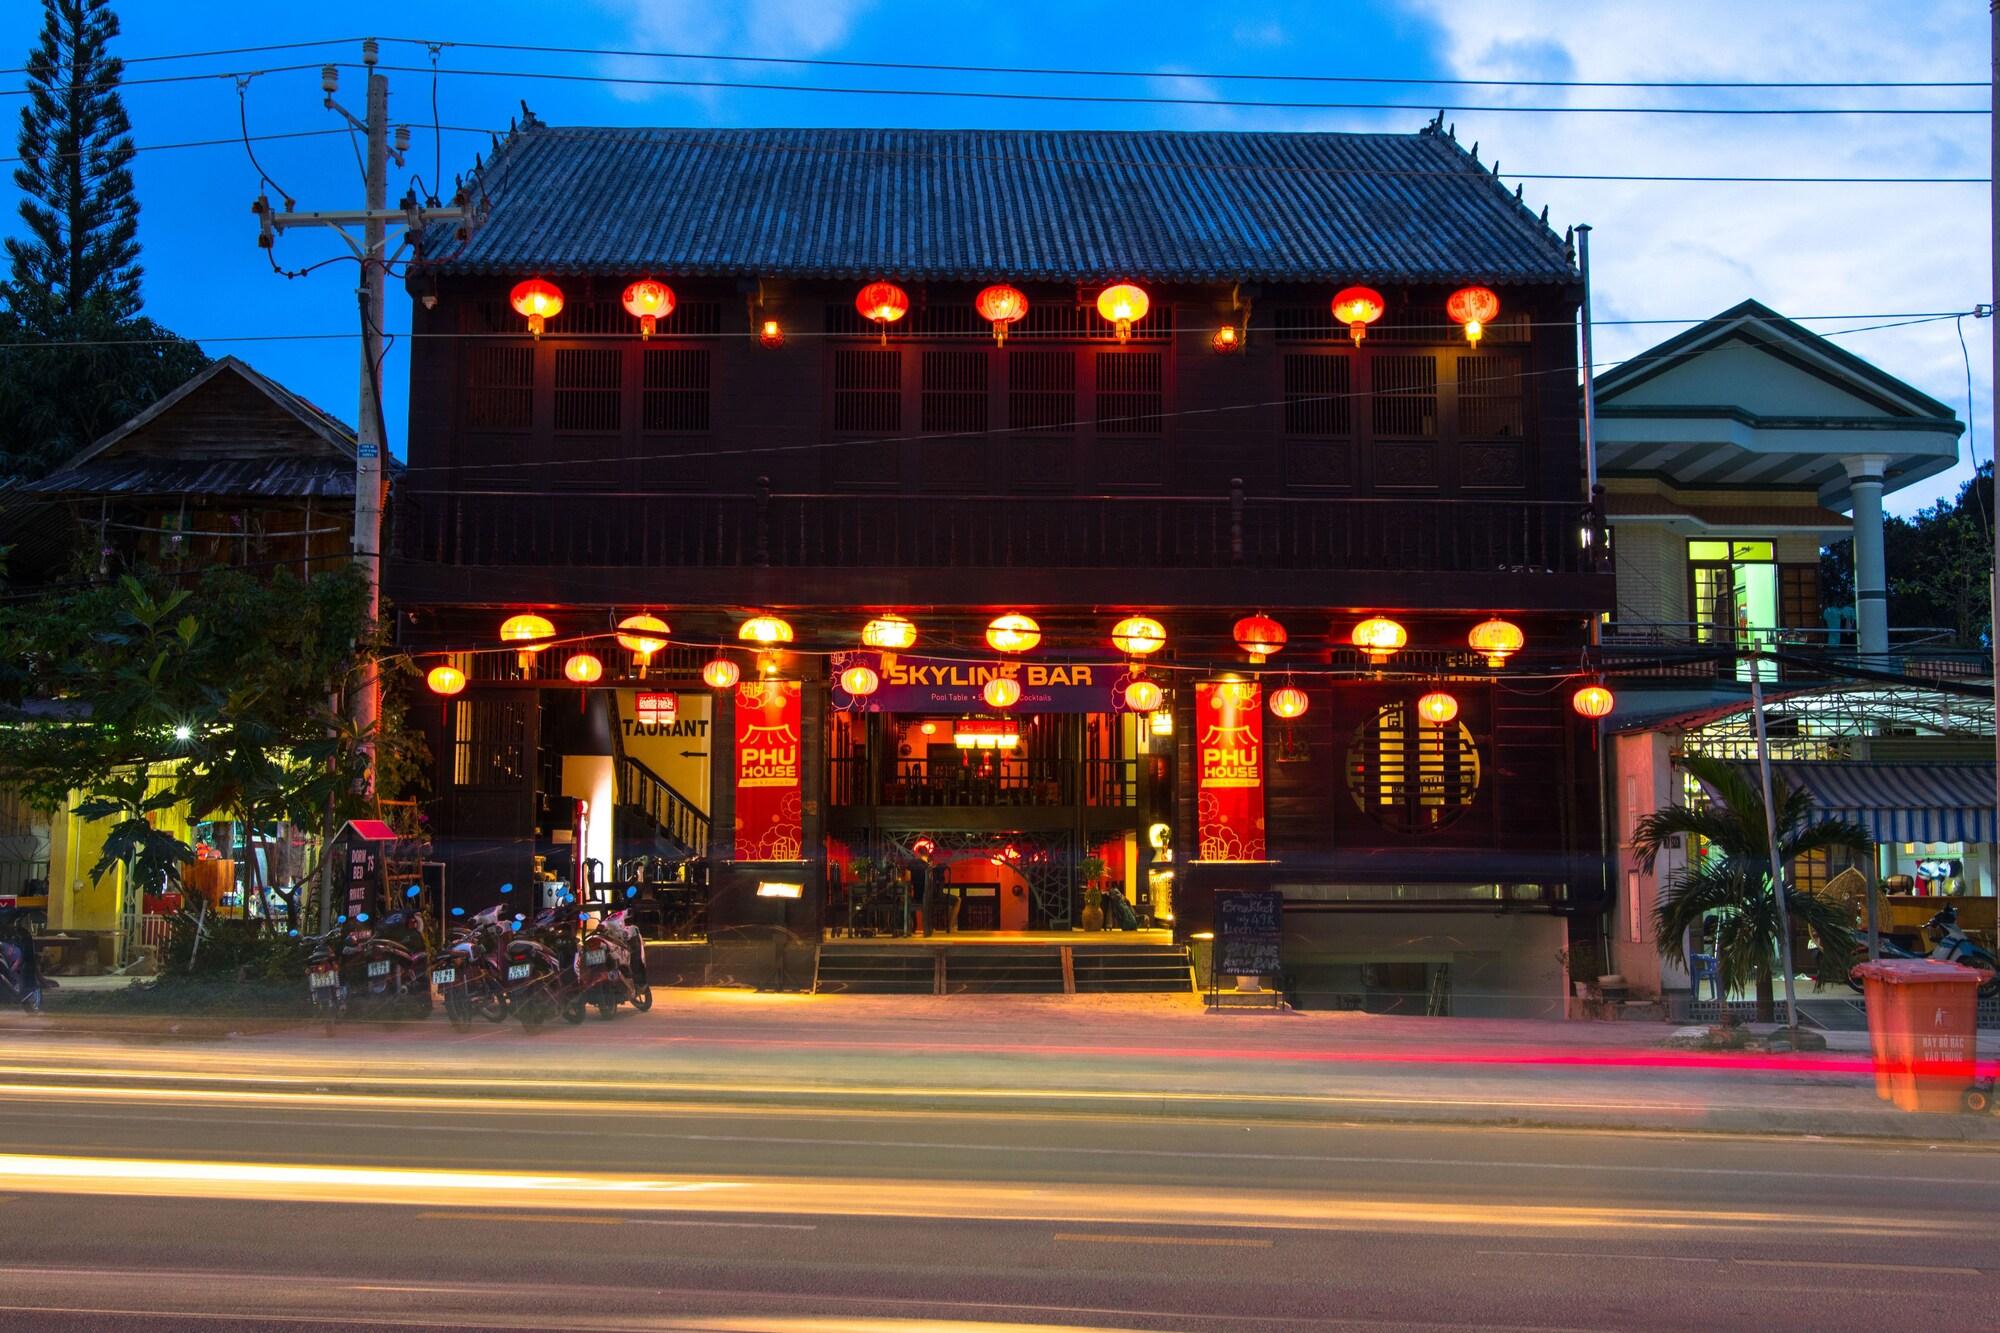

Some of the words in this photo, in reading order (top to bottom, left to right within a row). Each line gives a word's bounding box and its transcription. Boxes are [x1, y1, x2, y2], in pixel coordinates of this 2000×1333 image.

[1027, 666, 1093, 686] BAR
[931, 692, 947, 701] Pool
[949, 692, 968, 701] Table
[741, 765, 796, 778] HOUSE
[1204, 766, 1258, 778] HOUSE
[353, 865, 364, 880] BED
